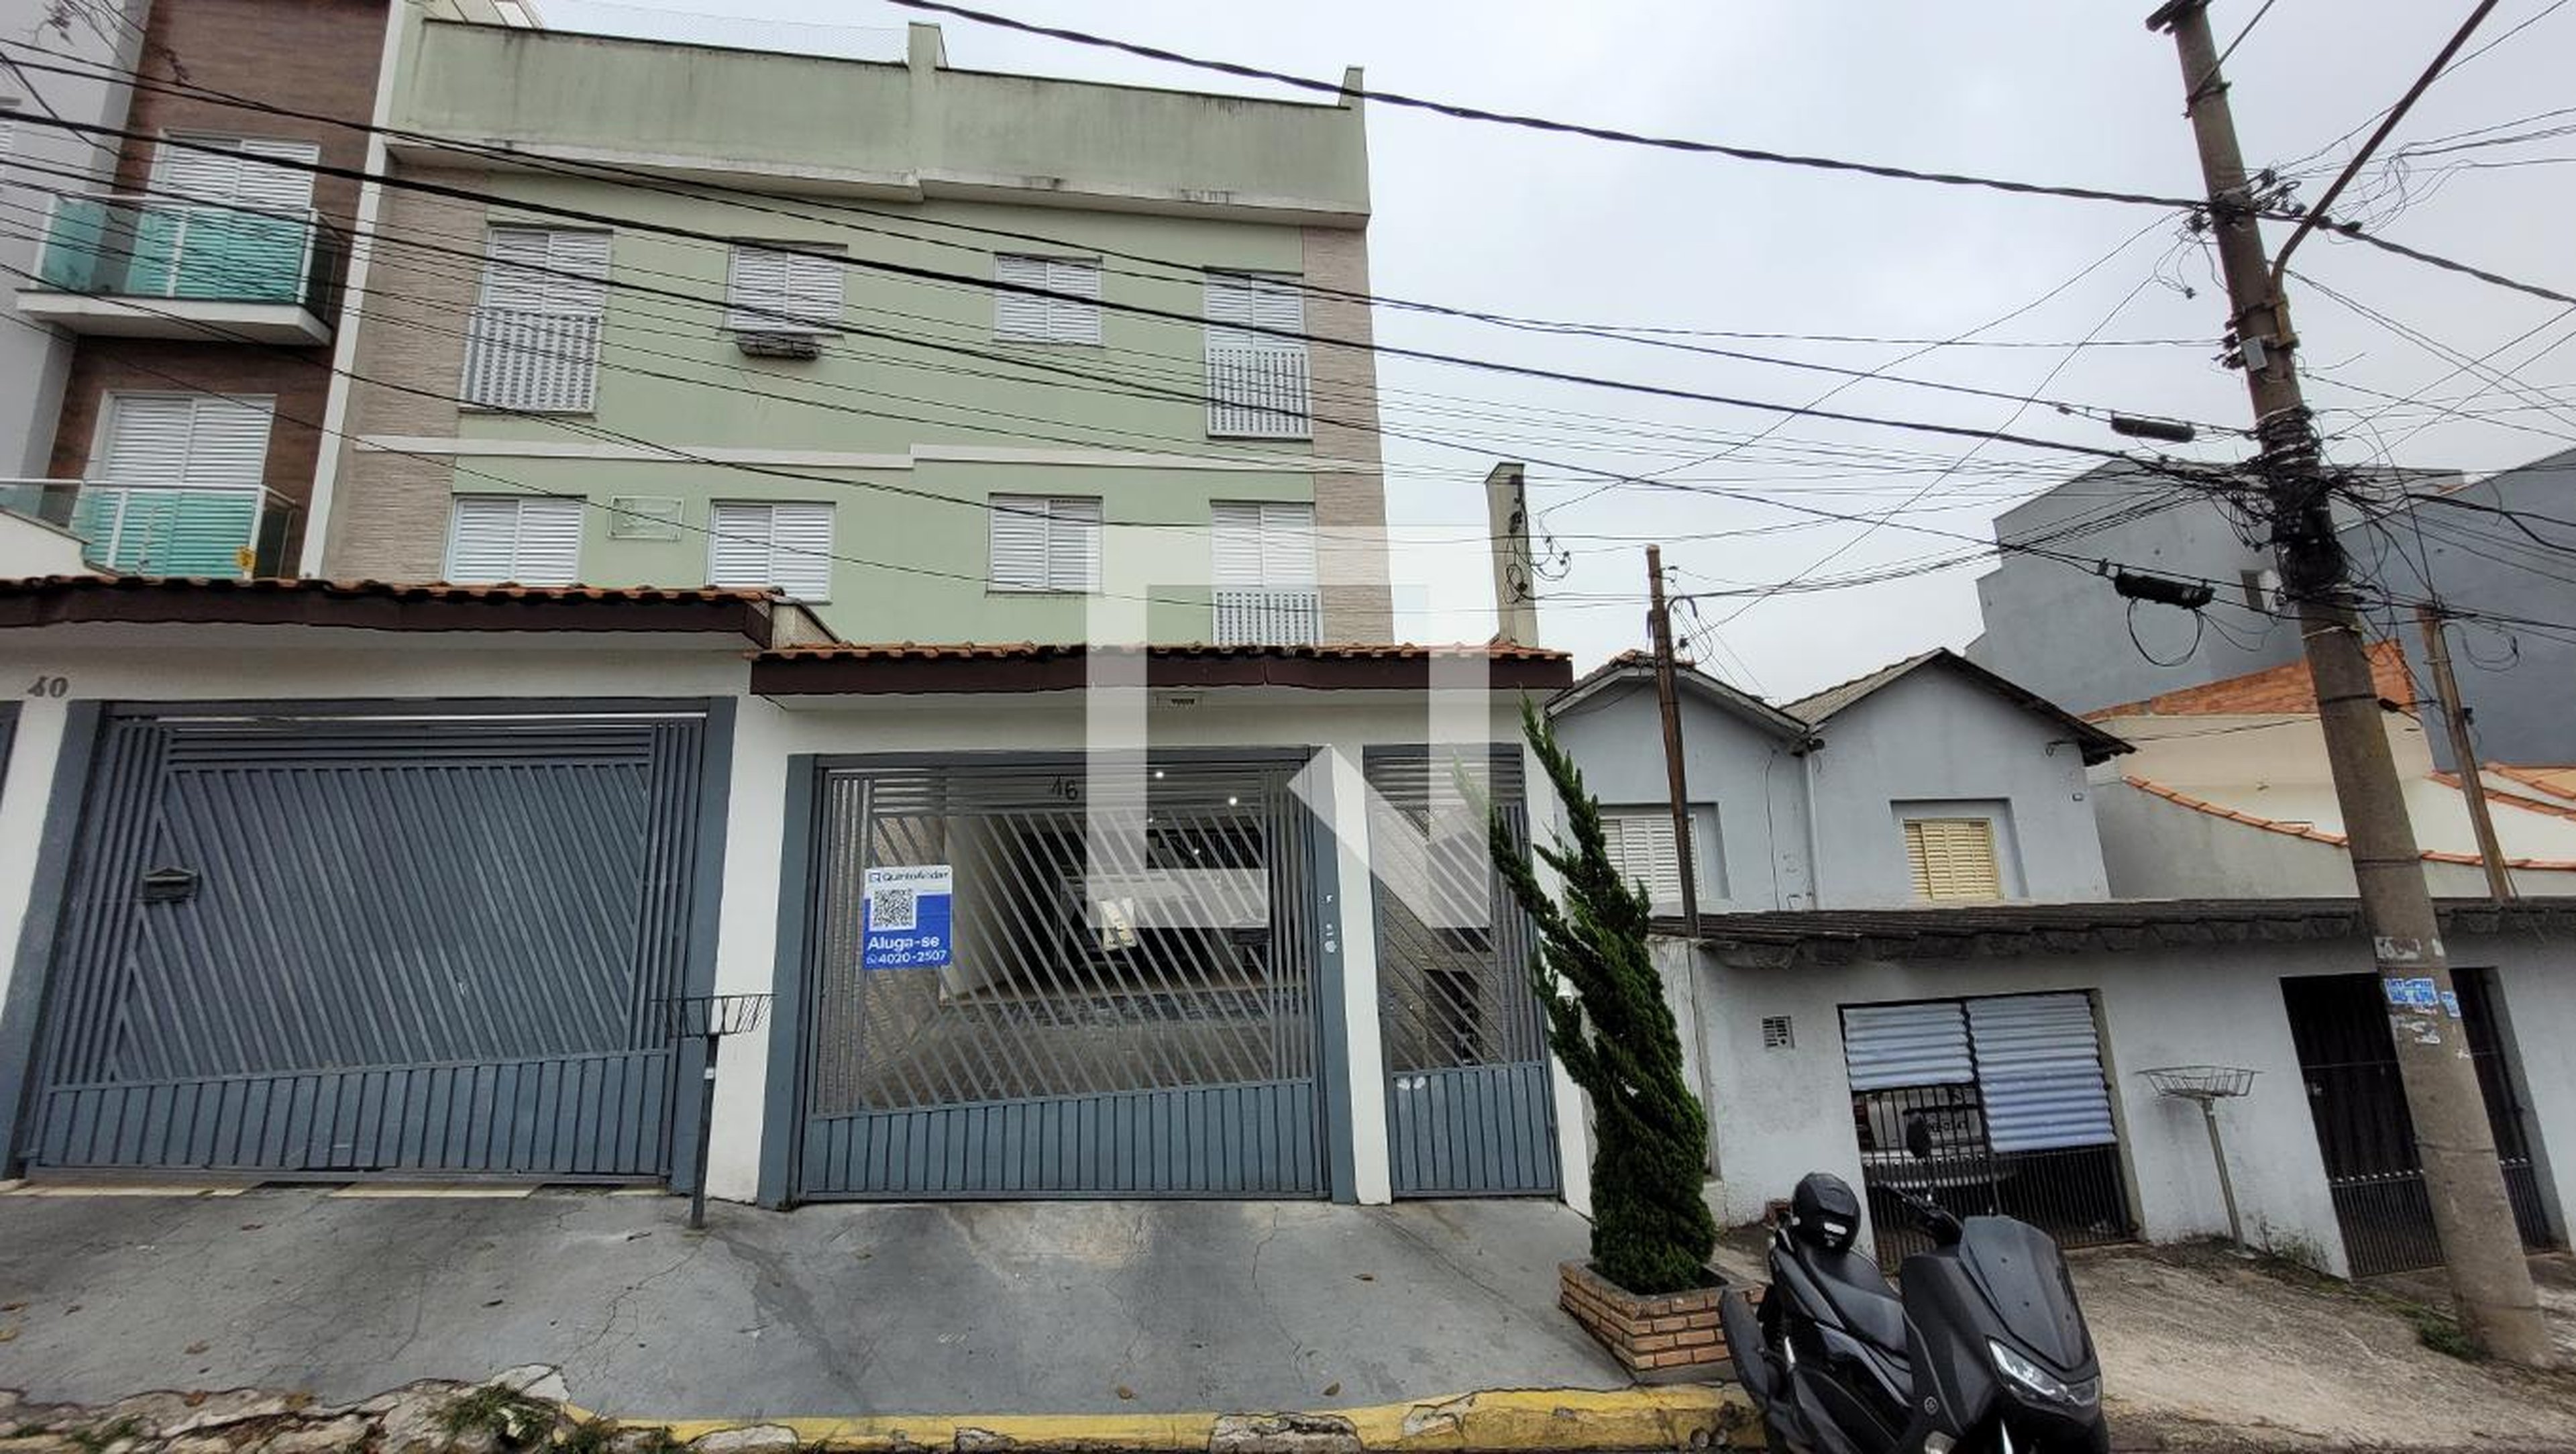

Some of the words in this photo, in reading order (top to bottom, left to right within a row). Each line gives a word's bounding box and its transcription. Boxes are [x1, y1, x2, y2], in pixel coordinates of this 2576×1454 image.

[27, 676, 69, 698] 40
[867, 936, 940, 952] Aluga-se
[878, 950, 947, 964] 4020-2507
